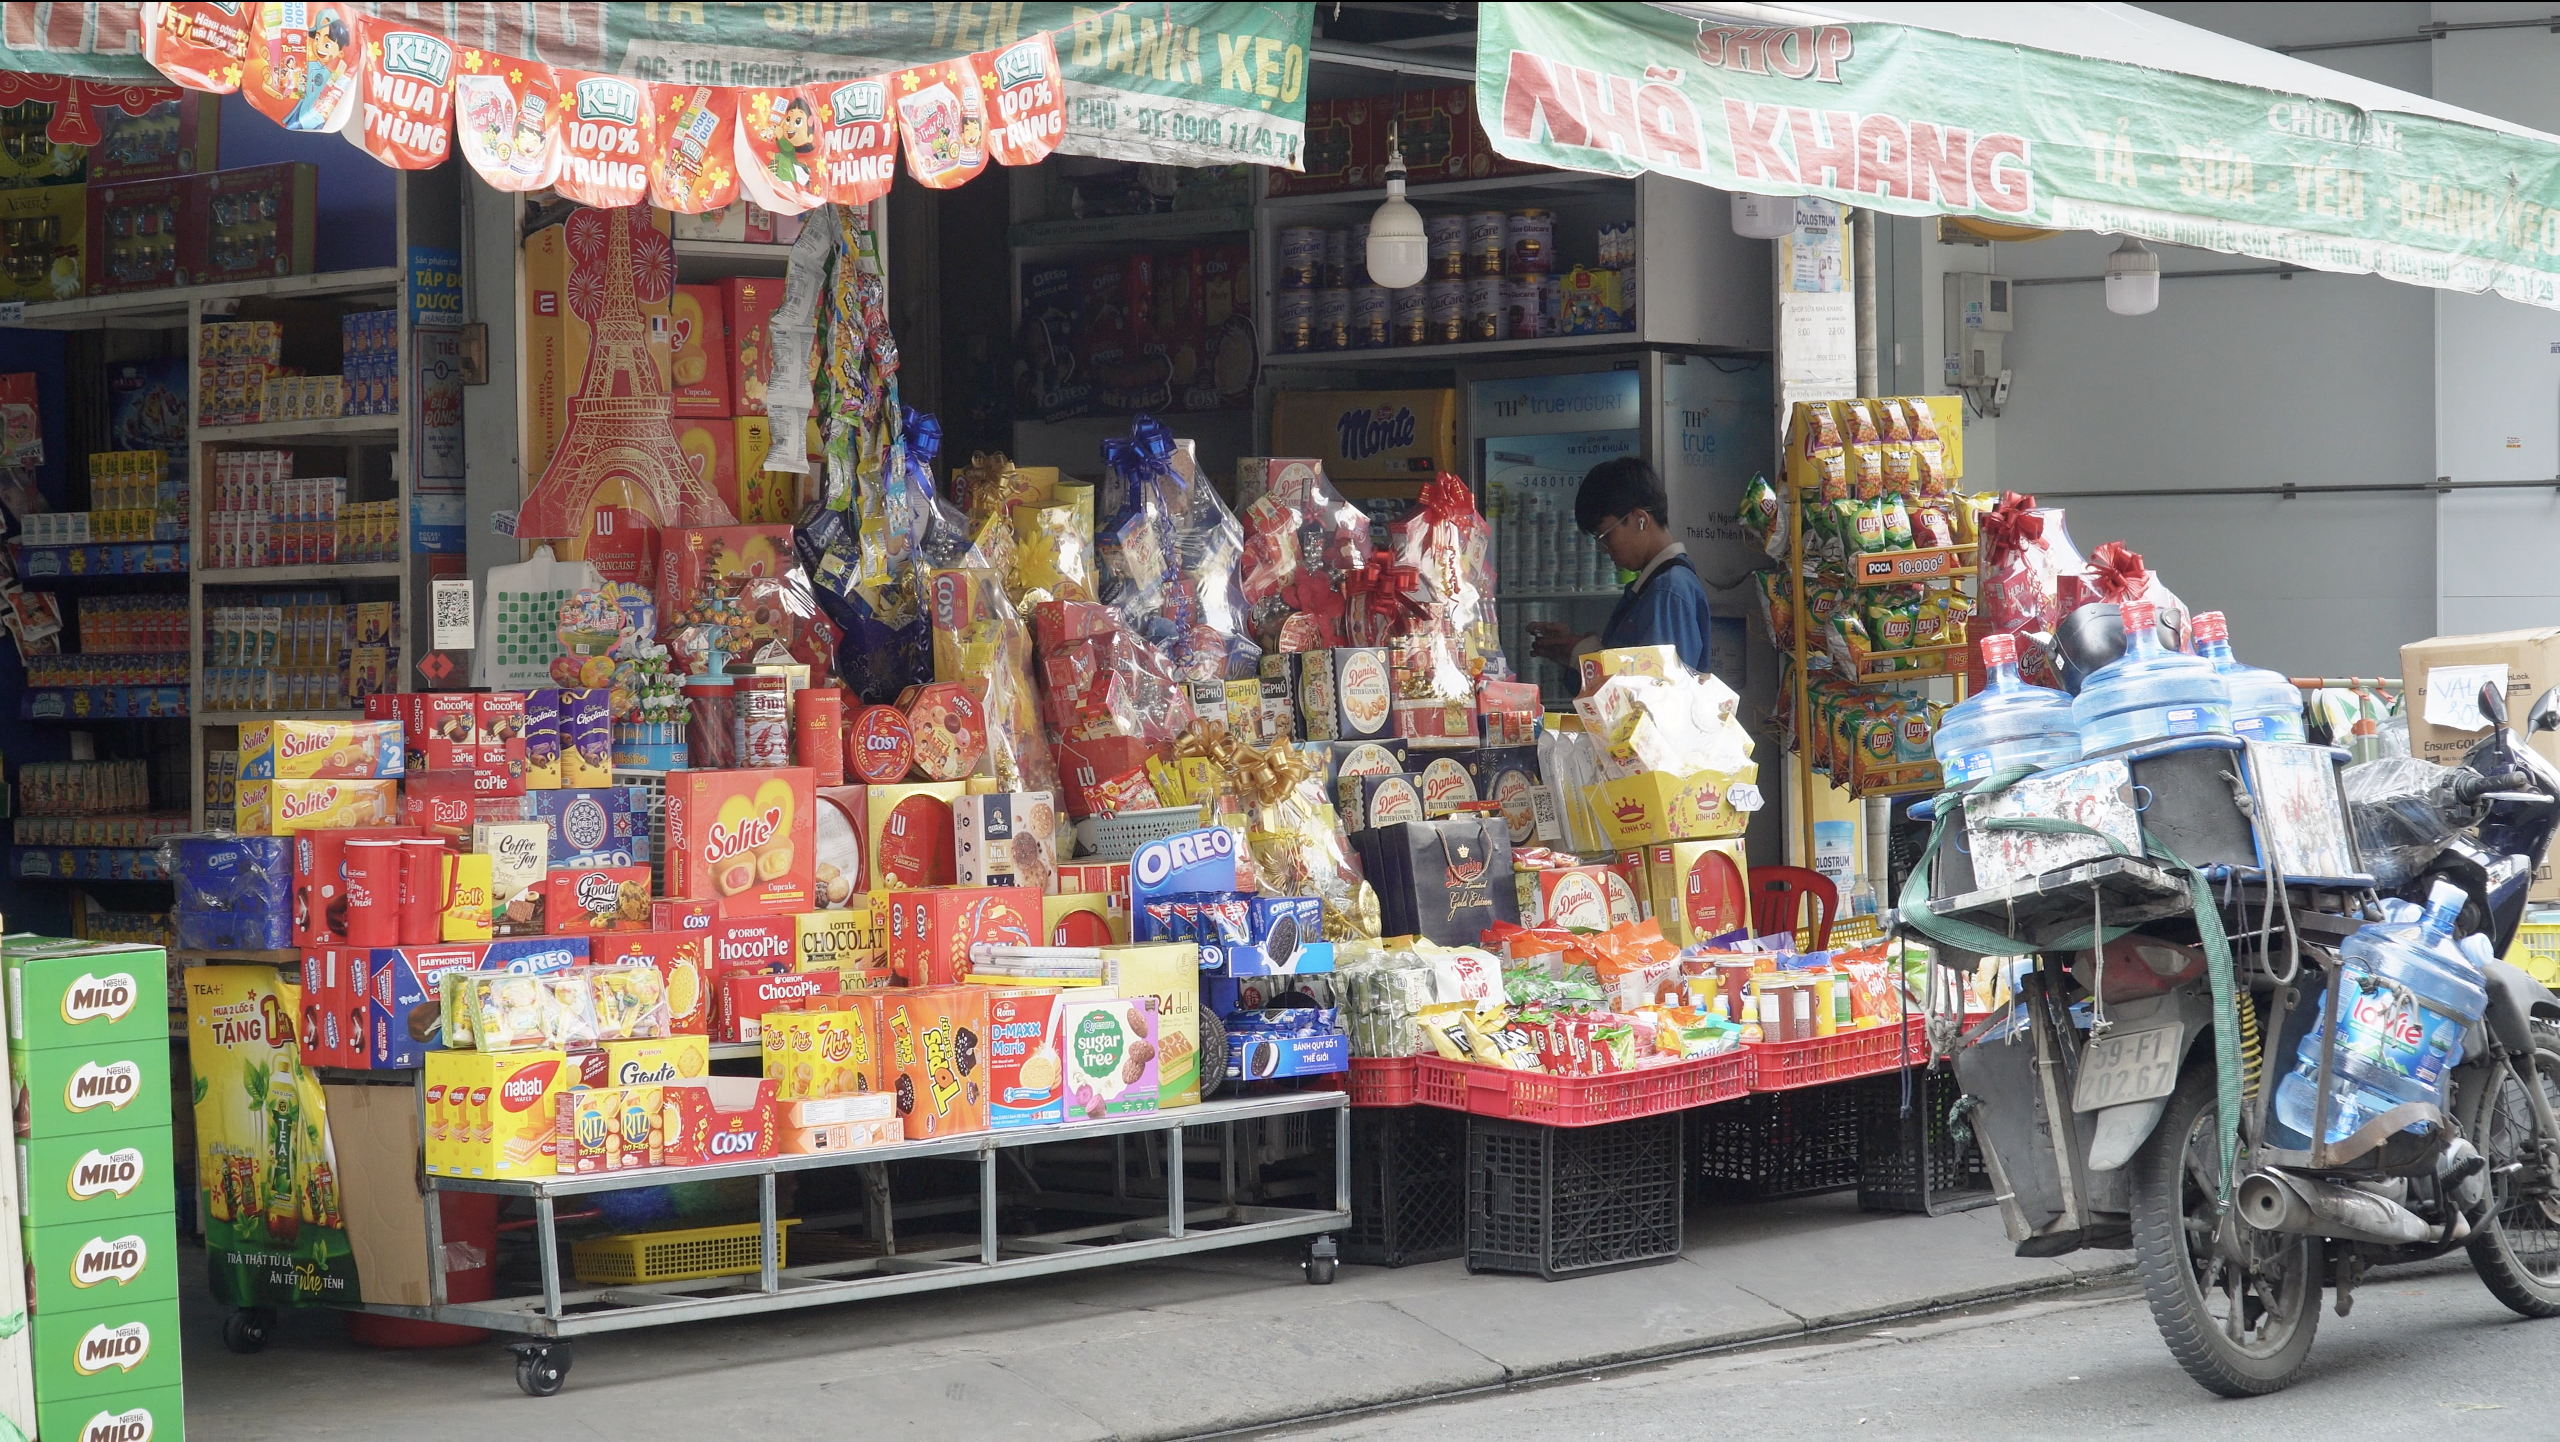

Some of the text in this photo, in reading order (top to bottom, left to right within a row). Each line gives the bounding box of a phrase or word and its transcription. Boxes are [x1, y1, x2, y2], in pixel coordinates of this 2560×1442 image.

[1697, 26, 1856, 86] SHOP
[1217, 32, 1303, 110] KẸO
[369, 71, 448, 118] MUA 1
[996, 83, 1053, 119] 100%
[365, 104, 447, 155] THÙNG
[825, 120, 892, 154] MUA 1
[989, 109, 1062, 154] TRÚNG
[1076, 97, 1117, 131] PHÚ
[1172, 112, 1222, 147] 0909
[1251, 126, 1273, 157] 29
[1503, 50, 2035, 216] NHÃ KHANG
[567, 121, 640, 156] 100%
[561, 148, 647, 190] TRÚNG
[826, 152, 894, 187] THÙNG
[2087, 116, 2139, 189] TẢ
[2178, 140, 2255, 206] SỮA
[2294, 151, 2366, 222] YẾN
[2400, 173, 2498, 243] BÁNH
[415, 268, 443, 291] TẬP
[416, 288, 461, 312] DƯỢC
[539, 294, 555, 312] LU
[424, 311, 445, 324] HÀNG
[684, 386, 712, 398] Cupcake
[1682, 410, 1702, 428] TH
[1336, 405, 1416, 461] Monte
[1682, 430, 1716, 454] true
[596, 511, 614, 536] LU
[1857, 515, 1883, 533] Lay's
[1883, 511, 1906, 528] Lay's
[1867, 562, 1893, 575] POCA
[2007, 582, 2026, 599] HURA
[1348, 665, 1379, 687] Danisa
[433, 700, 474, 712] ChocoPie
[482, 699, 524, 711] ChocoPie
[576, 707, 610, 724] Choclairs
[242, 730, 267, 752] Solite
[280, 728, 331, 760] Solite
[866, 734, 900, 751] COSY
[2424, 740, 2456, 752] Ensure
[1076, 765, 1097, 788] LU
[281, 788, 333, 821] Solite
[1378, 790, 1411, 815] Danisa
[1729, 788, 1759, 808] 470
[576, 818, 598, 829] OREO
[1695, 811, 1721, 821] KINH DO
[987, 824, 1009, 833] QUAKER
[1619, 822, 1652, 836] KINH DO
[499, 834, 537, 855] Coffee
[704, 816, 772, 864] Solite
[208, 851, 238, 868] OREO
[513, 850, 539, 870] Joy
[989, 845, 1007, 858] No.1
[1136, 829, 1233, 885] OREO
[576, 872, 619, 900] Goody
[768, 881, 797, 893] Cupcake
[1448, 891, 1493, 922] Gold Edition
[683, 915, 711, 929] COSY
[829, 920, 857, 930] LOTTE
[735, 927, 767, 939] ORION
[801, 927, 885, 951] CHOCOLAT
[420, 956, 473, 967] BABYMONSTER
[103, 978, 128, 987] Nestlé
[779, 975, 804, 985] ORION
[73, 986, 128, 1010] MILO
[758, 981, 822, 1001] ChocoPie
[213, 1006, 228, 1017] MUA
[229, 1006, 234, 1016] 2
[235, 1002, 249, 1016] LỐC
[996, 1007, 1016, 1018] Roma
[1176, 995, 1194, 1015] deli
[263, 998, 278, 1040] 1
[212, 1017, 262, 1051] TẶNG
[744, 1026, 754, 1038] 10
[991, 1021, 1041, 1041] D-MAXX
[991, 1040, 1026, 1056] Marie
[1077, 1034, 1121, 1056] sugar
[1293, 1039, 1333, 1052] BÁNH QUY SỐ
[2094, 1031, 2163, 1071] 59-F1
[1081, 1049, 1114, 1069] free
[1302, 1051, 1330, 1064] THẾ GIỚI
[106, 1065, 131, 1075] Nestlé
[76, 1074, 131, 1098] MILO
[504, 1078, 543, 1099] nabati
[514, 1095, 533, 1103] WAFER
[578, 1117, 607, 1142] RITZ
[621, 1114, 650, 1139] RITZ
[710, 1131, 757, 1156] COSY
[79, 1162, 135, 1187] MILO
[82, 1249, 138, 1273] MILO
[226, 1250, 243, 1264] TRÀ
[244, 1251, 268, 1267] THẬT
[269, 1251, 281, 1266] TỪ
[269, 1264, 345, 1296] ĂN TẾT nhẹ TÊNH
[85, 1336, 141, 1361] MILO
